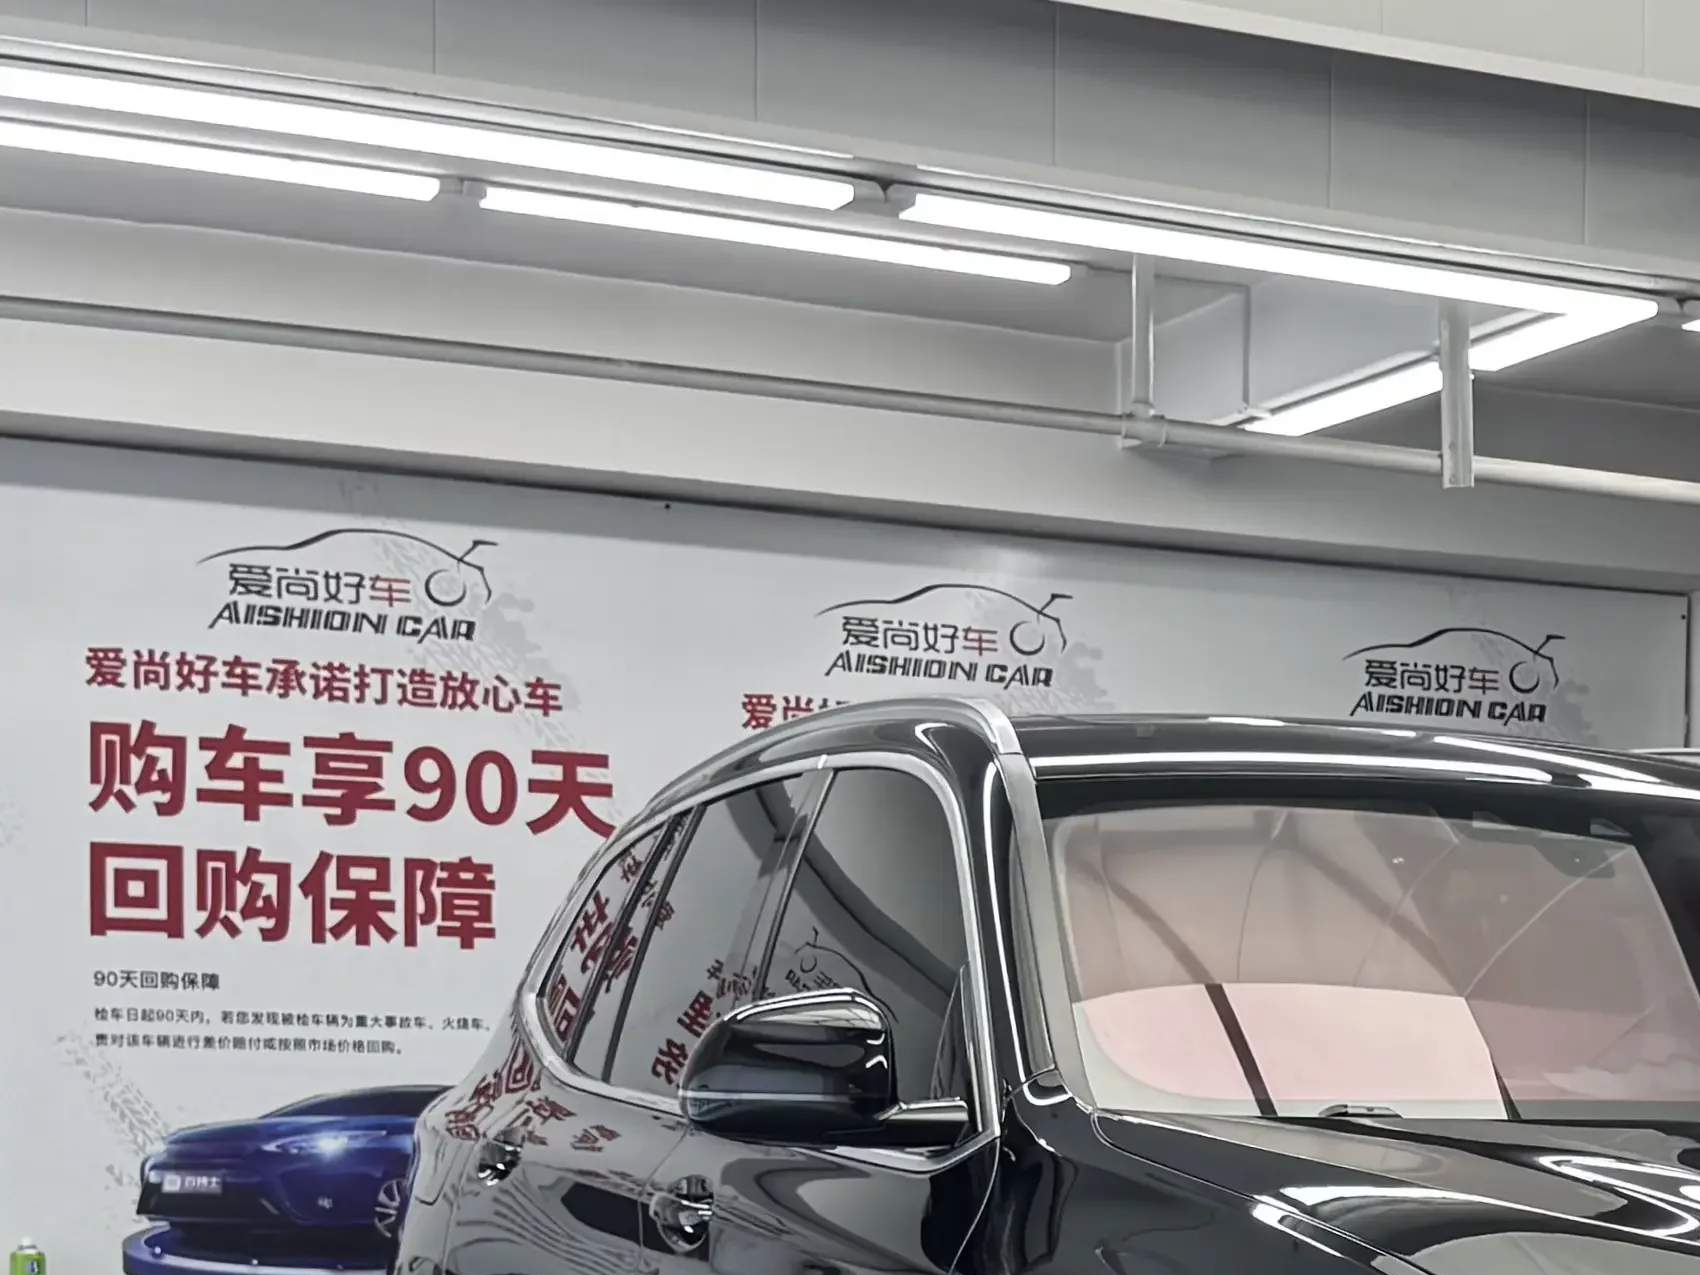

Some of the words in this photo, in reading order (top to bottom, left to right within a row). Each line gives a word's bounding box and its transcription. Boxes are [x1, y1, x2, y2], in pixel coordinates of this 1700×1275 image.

[229, 563, 411, 608] 爱尚好车
[208, 600, 388, 635] AISHION
[396, 615, 477, 644] CAR
[842, 616, 998, 656] 爱尚好车
[85, 647, 563, 717] 爱尚好车承诺打造放心车
[824, 650, 978, 682] AISHION
[985, 663, 1054, 689] CAR
[1365, 659, 1499, 695] 爱尚好车
[1350, 691, 1482, 718] AISHION
[1488, 700, 1546, 726] CAR
[89, 720, 617, 840] 购车享90天
[89, 841, 497, 949] 回购保障
[93, 970, 220, 990] 90天回购保障
